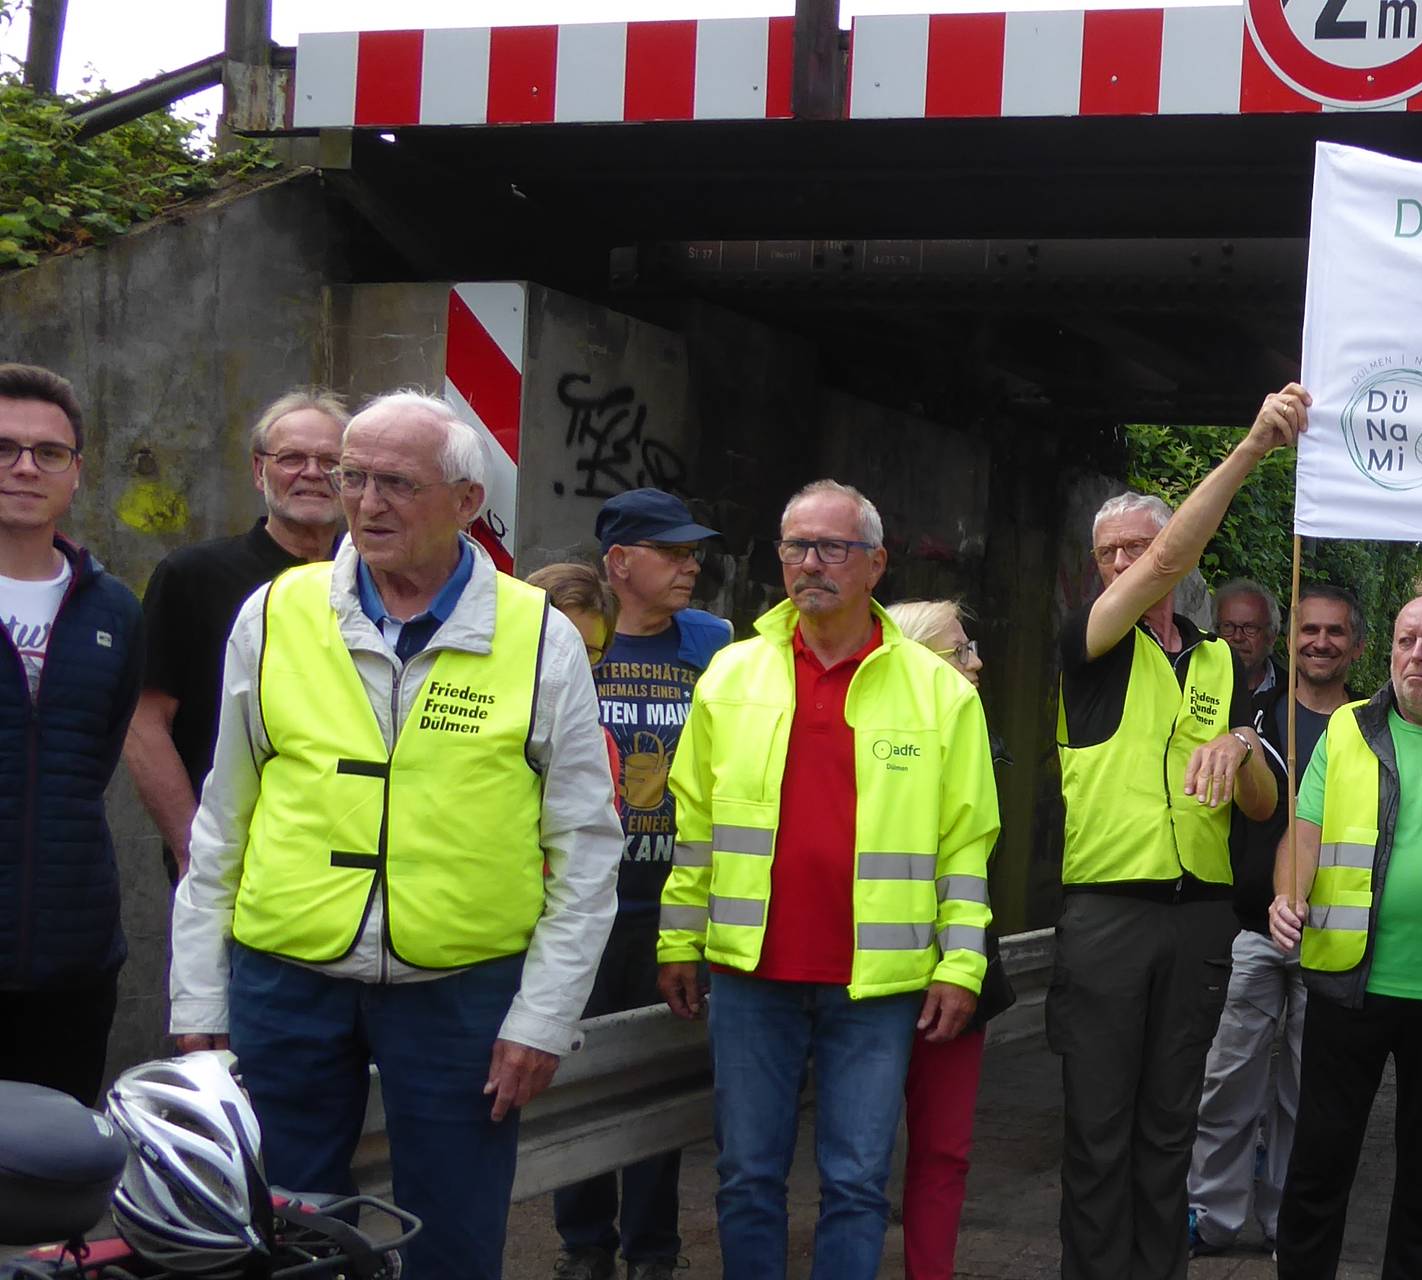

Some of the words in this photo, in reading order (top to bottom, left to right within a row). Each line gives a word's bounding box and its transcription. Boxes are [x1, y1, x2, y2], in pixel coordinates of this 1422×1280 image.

[1378, 0, 1416, 39] m
[1367, 389, 1408, 413] Dü
[1366, 418, 1409, 442] Na
[1367, 446, 1404, 472] Mi
[597, 662, 696, 685] TERSCHÄTZE
[429, 681, 496, 704] Friedens
[598, 683, 648, 698] NIEMALS
[650, 684, 681, 700] EINEN
[424, 698, 488, 719] Freunde
[600, 701, 638, 725] TEN
[419, 715, 480, 734] Dülmen
[893, 744, 920, 757] adfc
[628, 816, 670, 833] EINER
